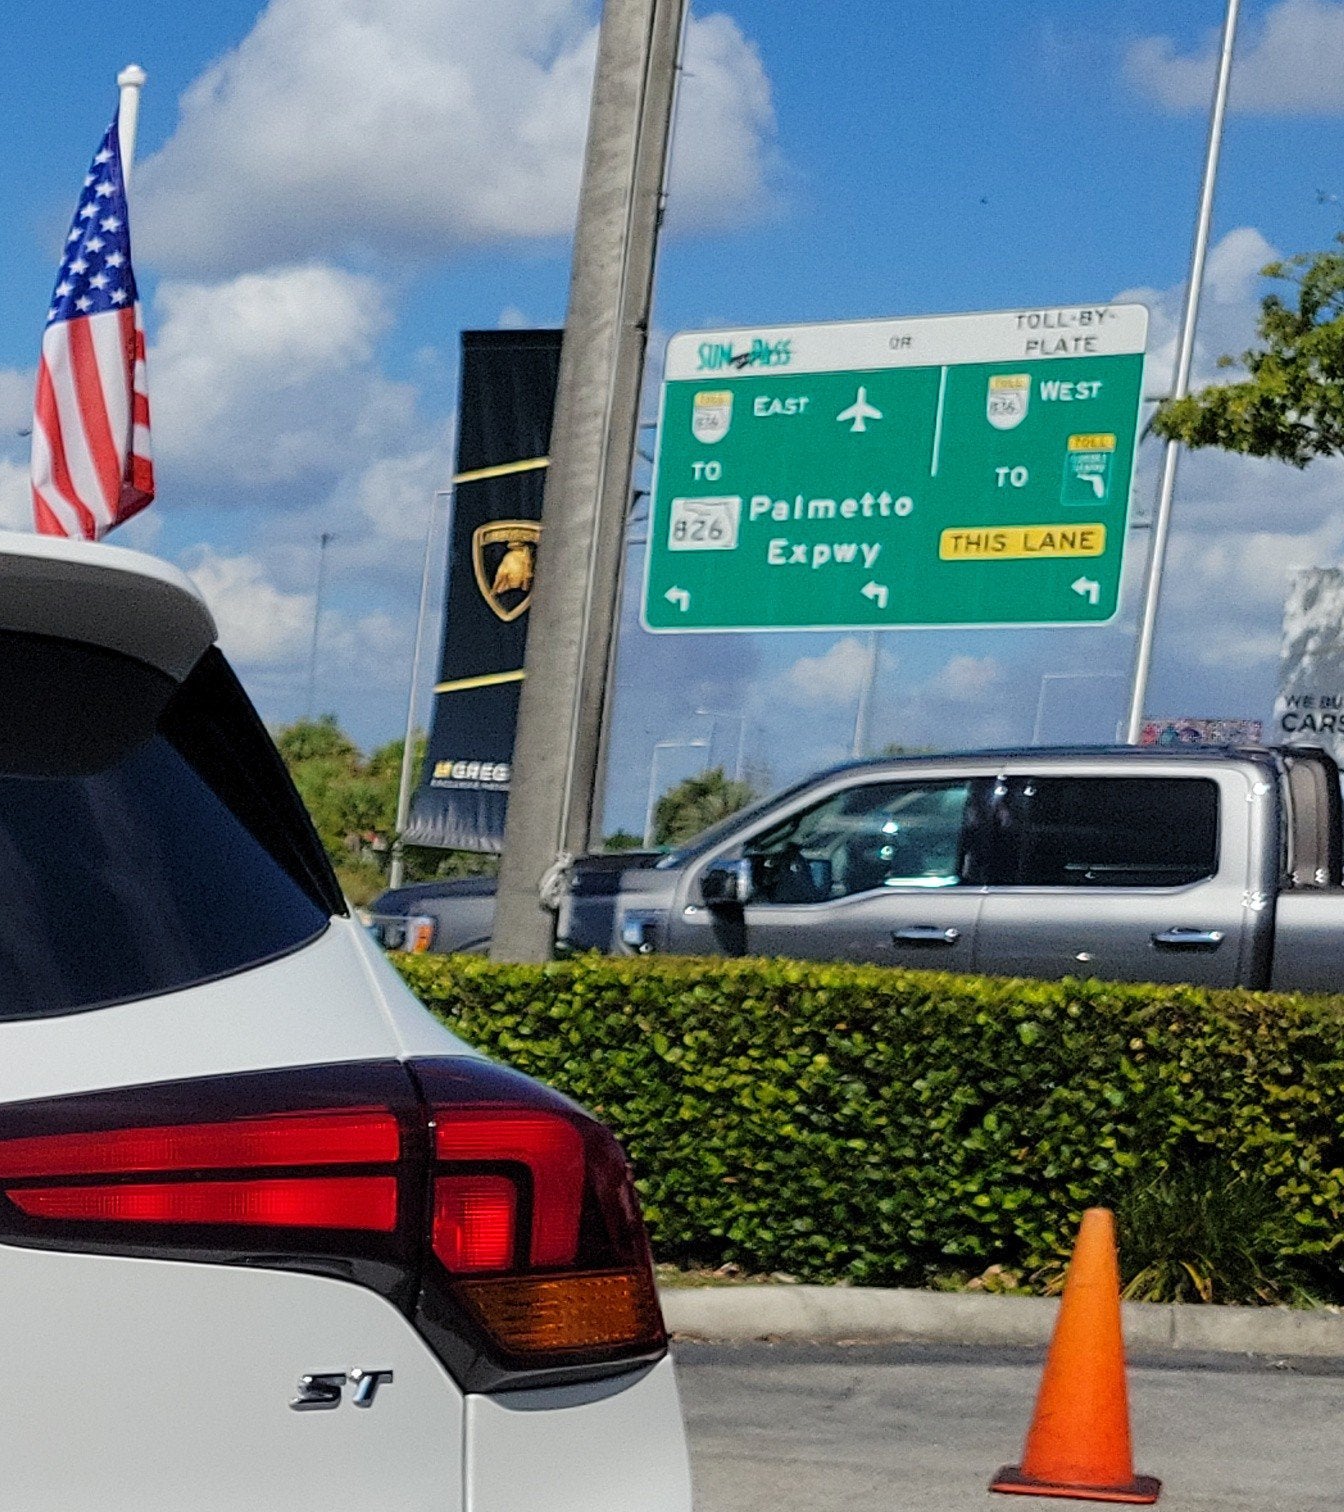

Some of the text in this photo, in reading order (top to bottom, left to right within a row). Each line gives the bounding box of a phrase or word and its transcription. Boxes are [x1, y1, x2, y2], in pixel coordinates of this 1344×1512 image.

[889, 336, 913, 350] OR
[1025, 335, 1099, 355] PLATE
[1040, 380, 1103, 401] WEST
[753, 396, 809, 417] EAST
[691, 461, 722, 481] TO
[995, 466, 1029, 487] TO
[749, 491, 914, 521] Palmetto
[674, 520, 723, 541] 826
[951, 530, 1096, 553] THIS LANE
[767, 538, 882, 569] Expwy
[1284, 695, 1315, 709] WE
[288, 1368, 394, 1412] ST
